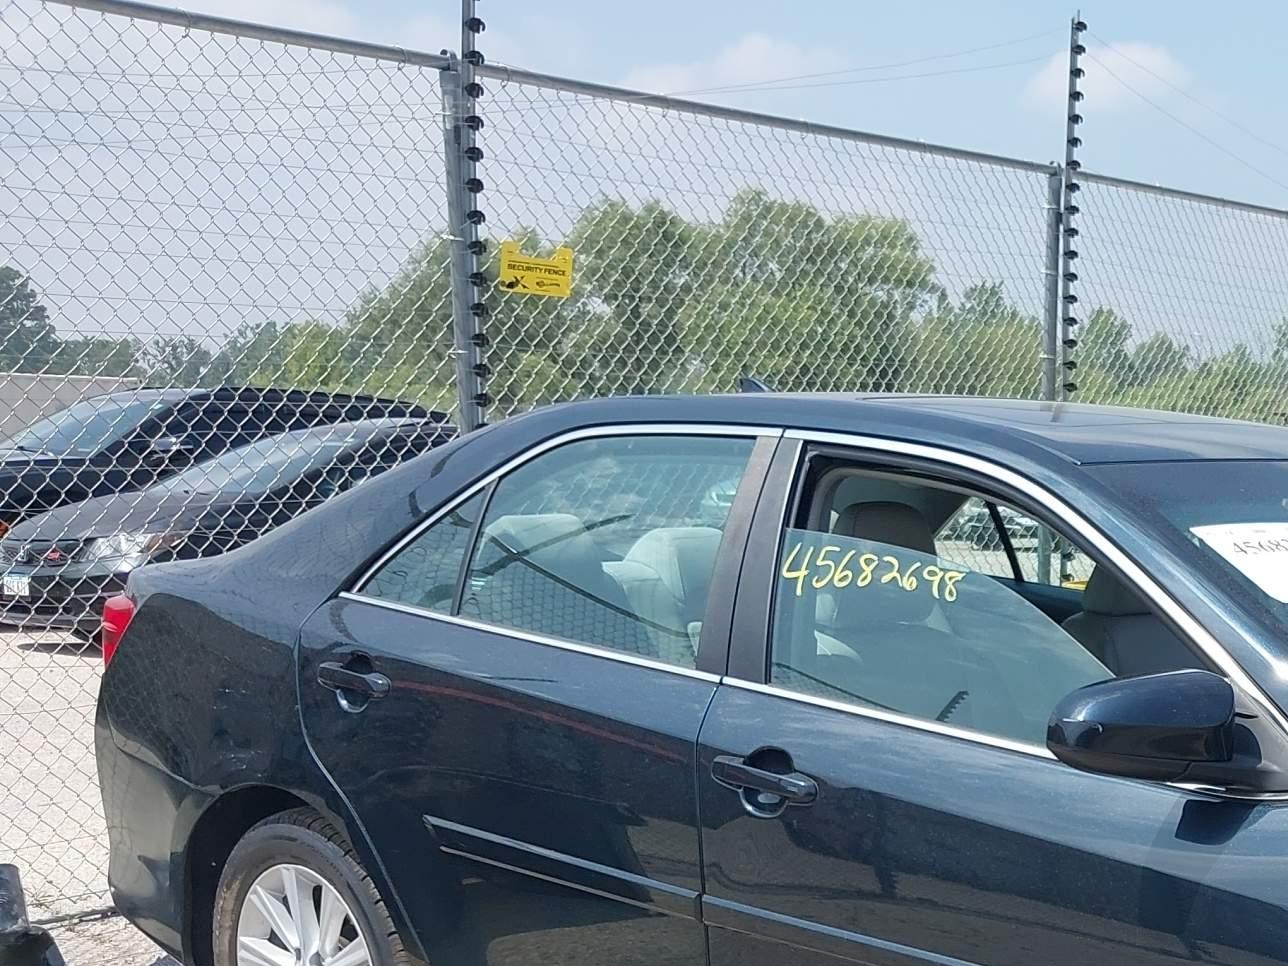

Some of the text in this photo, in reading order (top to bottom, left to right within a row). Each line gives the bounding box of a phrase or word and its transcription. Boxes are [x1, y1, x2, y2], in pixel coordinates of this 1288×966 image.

[507, 262, 544, 274] SECURITY
[543, 267, 567, 277] FENCE
[781, 542, 967, 602] 45682698
